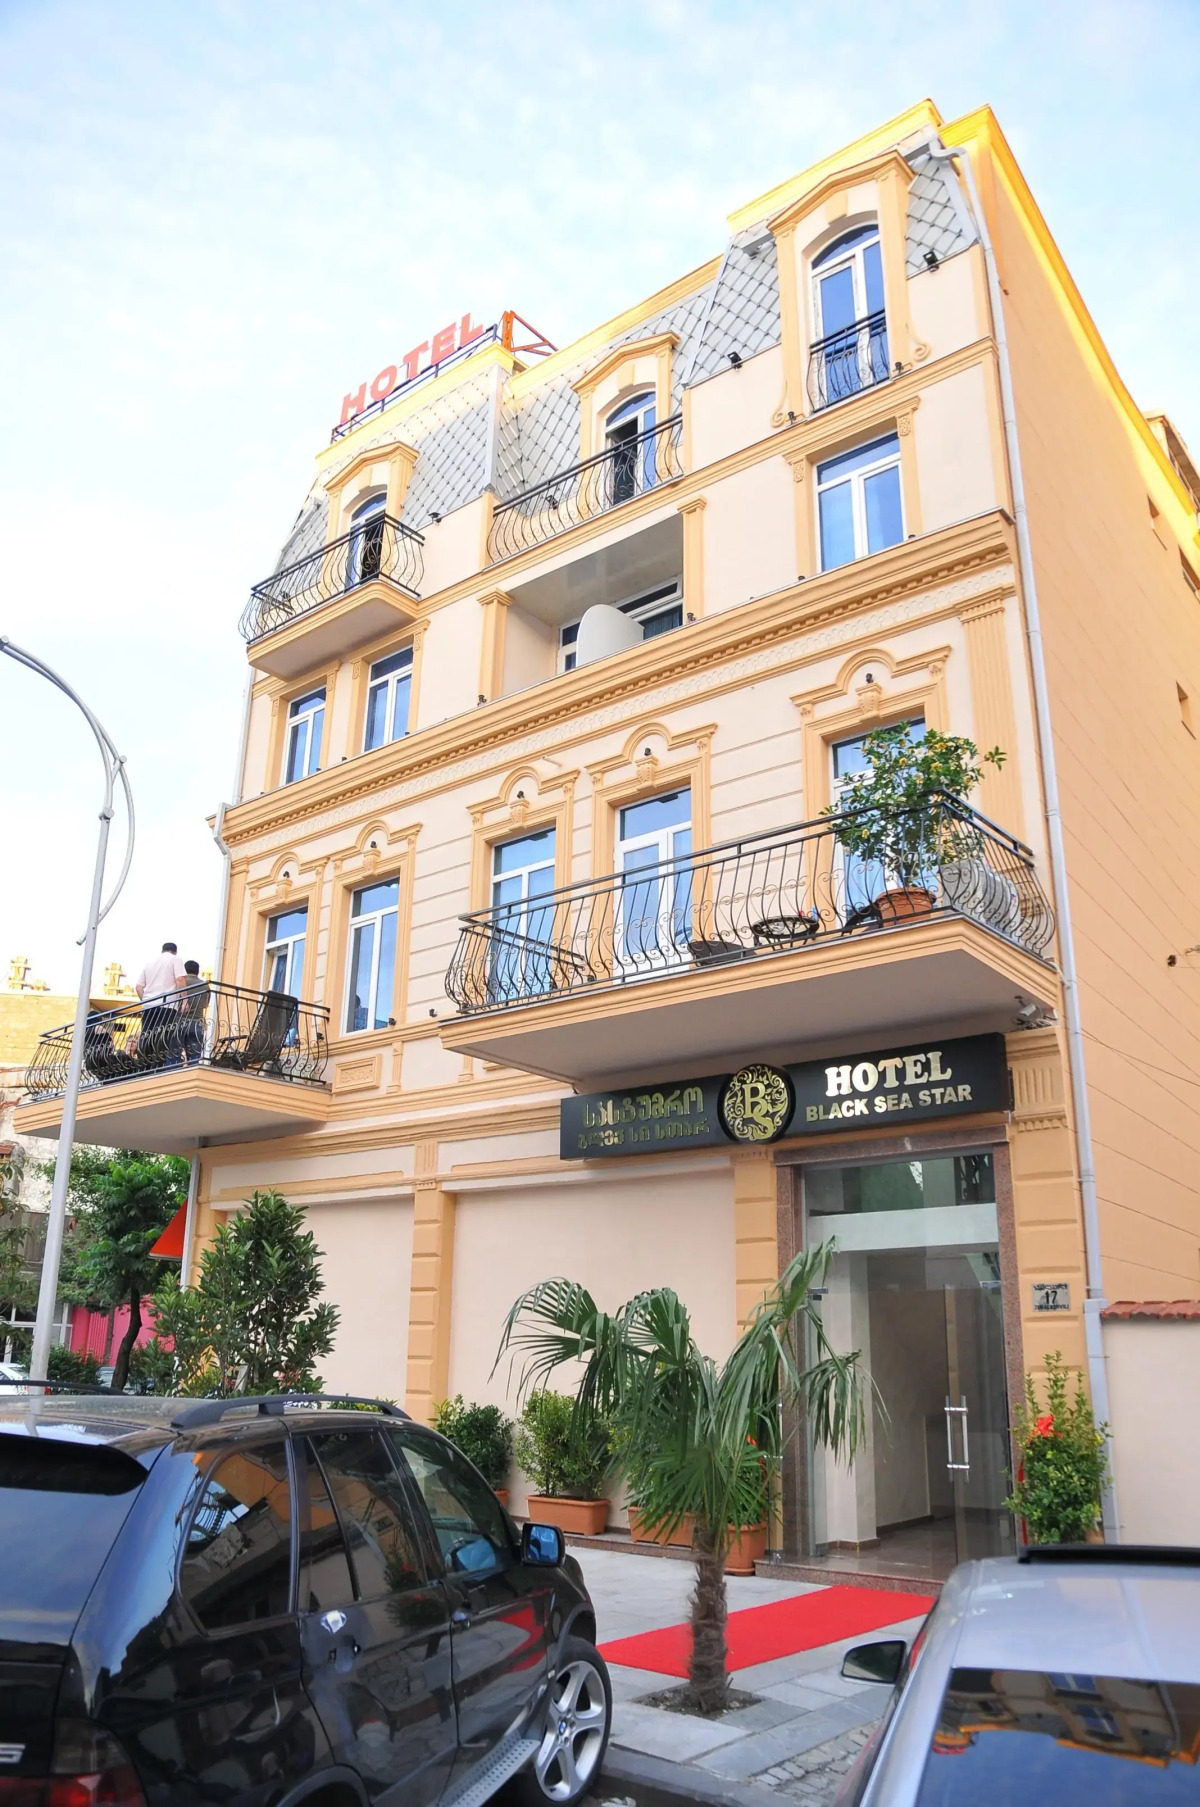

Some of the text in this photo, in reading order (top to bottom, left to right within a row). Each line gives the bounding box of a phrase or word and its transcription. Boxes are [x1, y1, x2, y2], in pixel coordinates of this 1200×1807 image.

[340, 312, 483, 424] HOTEL
[824, 1051, 952, 1097] HOTEL
[583, 1086, 704, 1129] სასტუმრო
[806, 1084, 973, 1122] BLACK SEA STAR
[1045, 1290, 1058, 1304] 17
